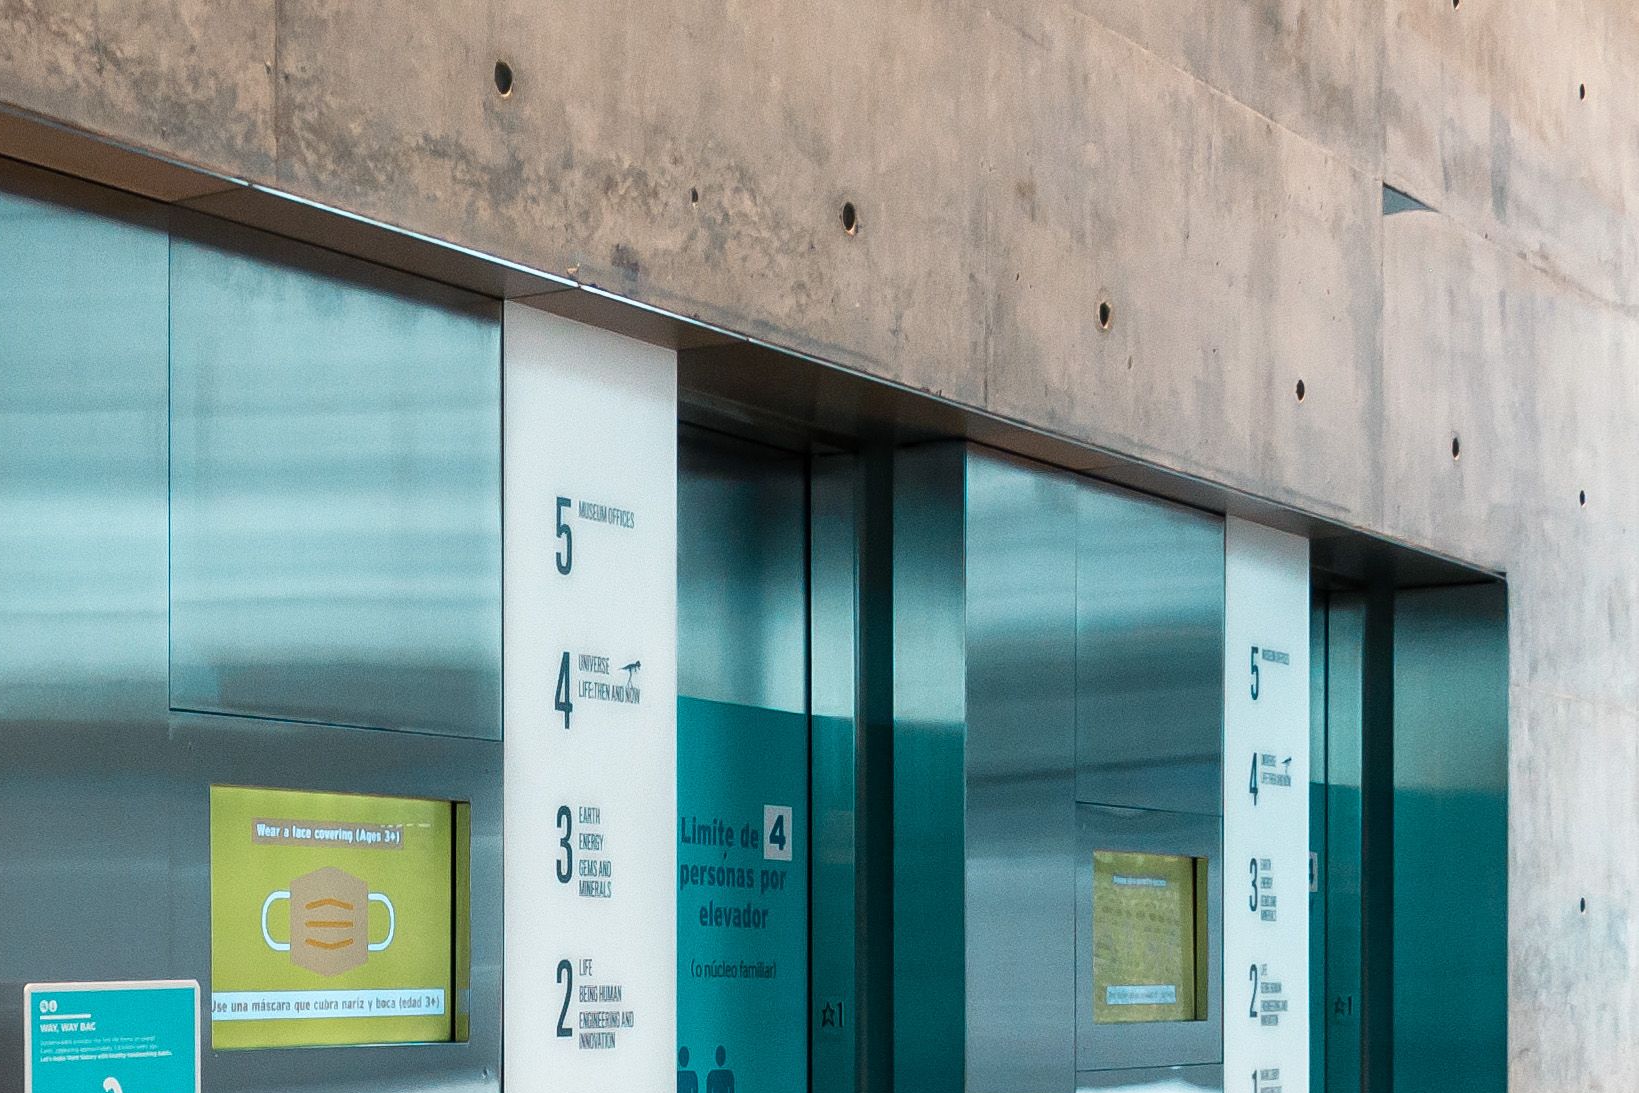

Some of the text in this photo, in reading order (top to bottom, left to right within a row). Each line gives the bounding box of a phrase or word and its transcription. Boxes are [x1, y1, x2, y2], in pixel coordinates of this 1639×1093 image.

[578, 500, 635, 529] MUSEUM OFFICES
[556, 496, 573, 575] 5
[578, 654, 610, 675] UNIVERSE
[1251, 646, 1259, 700] 5
[555, 652, 573, 729] 4
[1250, 752, 1258, 806] 4
[578, 806, 601, 825] EARTH
[256, 823, 281, 838] Wear
[283, 828, 289, 838] a
[314, 826, 353, 844] covering
[556, 805, 573, 884] 3
[578, 833, 604, 851] ENERGY
[681, 814, 787, 851] Limite de 4
[578, 860, 612, 878] GEMS AND
[679, 862, 787, 894] personas por
[578, 880, 612, 899] MINERALS
[1249, 858, 1258, 911] 3
[699, 899, 769, 929] elevador
[578, 958, 593, 977] LIFE
[704, 959, 738, 978] núcleo
[739, 960, 777, 979] familiar)
[556, 959, 573, 1038] 2
[578, 985, 622, 1003] BEING HUMAN
[1249, 963, 1258, 1018] 2
[231, 1001, 249, 1013] una
[252, 998, 291, 1012] máscara
[294, 1000, 311, 1013] que
[368, 999, 373, 1012] y
[578, 1010, 634, 1029] ENGINEERING AND
[578, 1031, 616, 1050] INNOVATION
